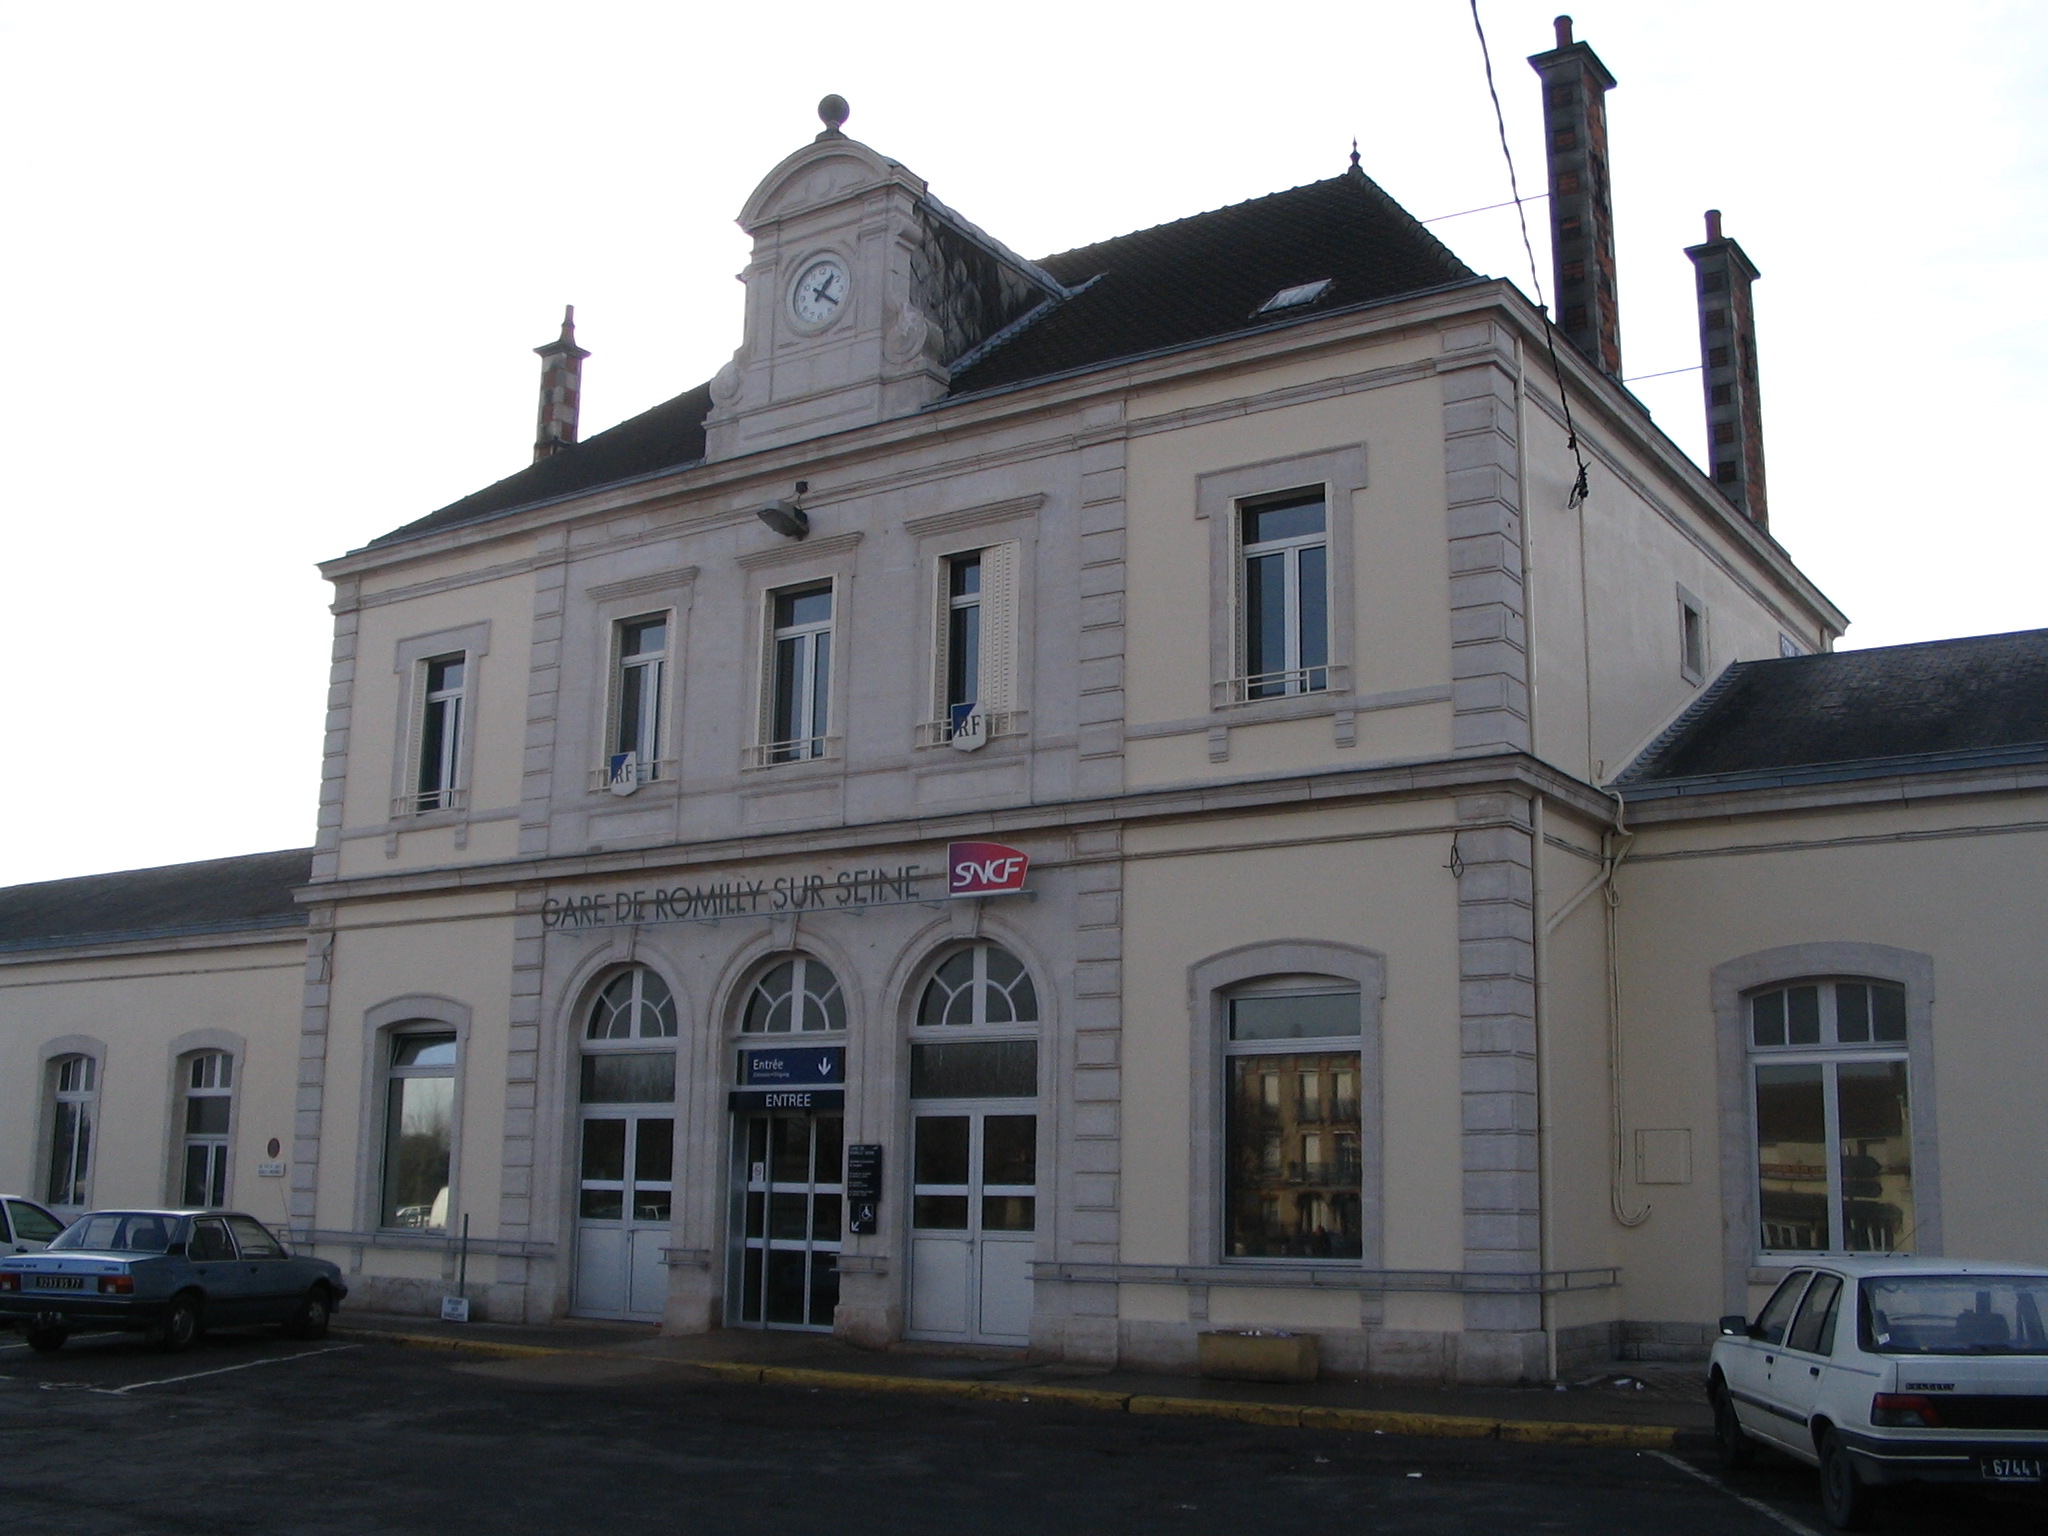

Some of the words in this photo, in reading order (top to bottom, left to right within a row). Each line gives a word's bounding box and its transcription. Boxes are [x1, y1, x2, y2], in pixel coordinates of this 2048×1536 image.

[958, 714, 981, 737] RF
[614, 763, 633, 783] RF
[953, 857, 1024, 887] SNCF
[541, 894, 606, 927] GARE
[616, 890, 646, 922] DE
[656, 880, 763, 920] ROMILLY
[773, 875, 825, 911] SUR
[836, 865, 920, 905] SEINE
[753, 1058, 784, 1070] Entrée
[765, 1093, 811, 1107] ENTREE
[1993, 1458, 2031, 1476] 6744
